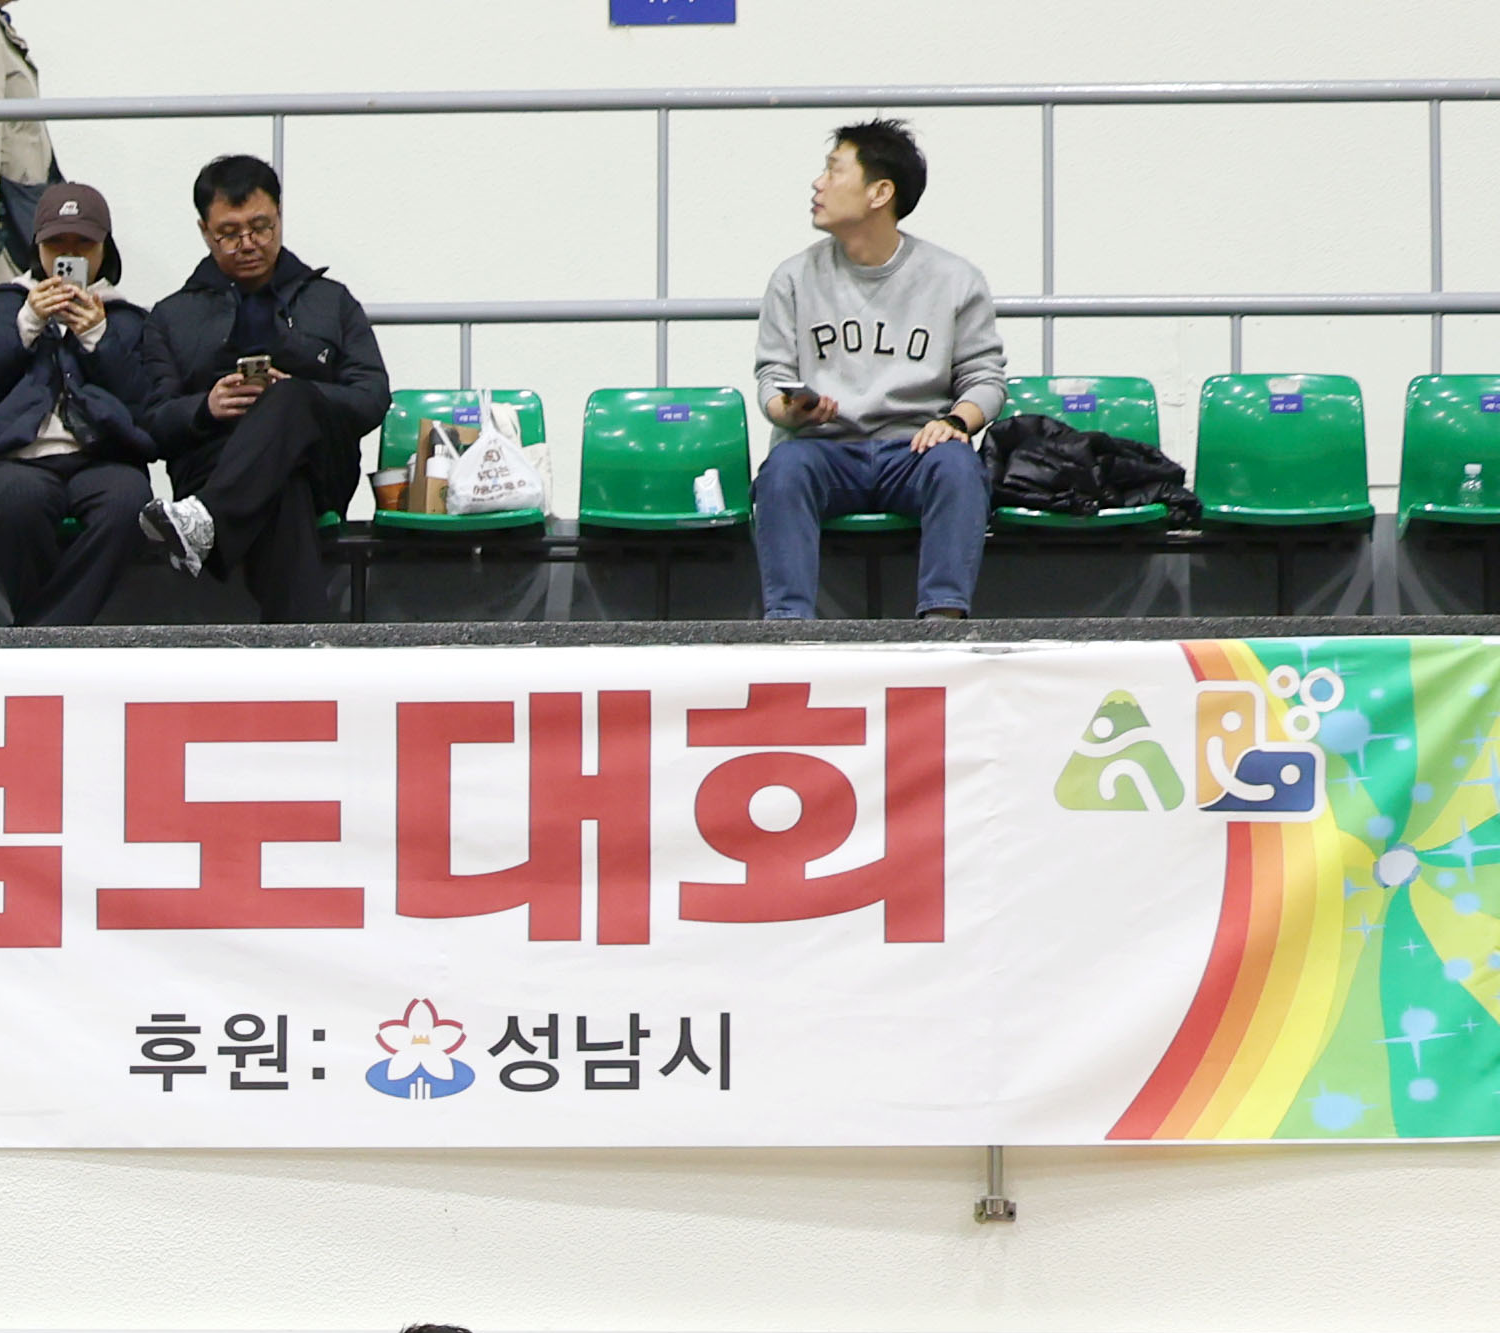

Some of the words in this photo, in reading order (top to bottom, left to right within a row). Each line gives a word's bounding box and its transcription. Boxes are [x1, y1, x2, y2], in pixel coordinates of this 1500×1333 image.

[810, 319, 929, 361] POLO
[129, 1013, 327, 1093] 후원:
[486, 1012, 732, 1093] 성남시
